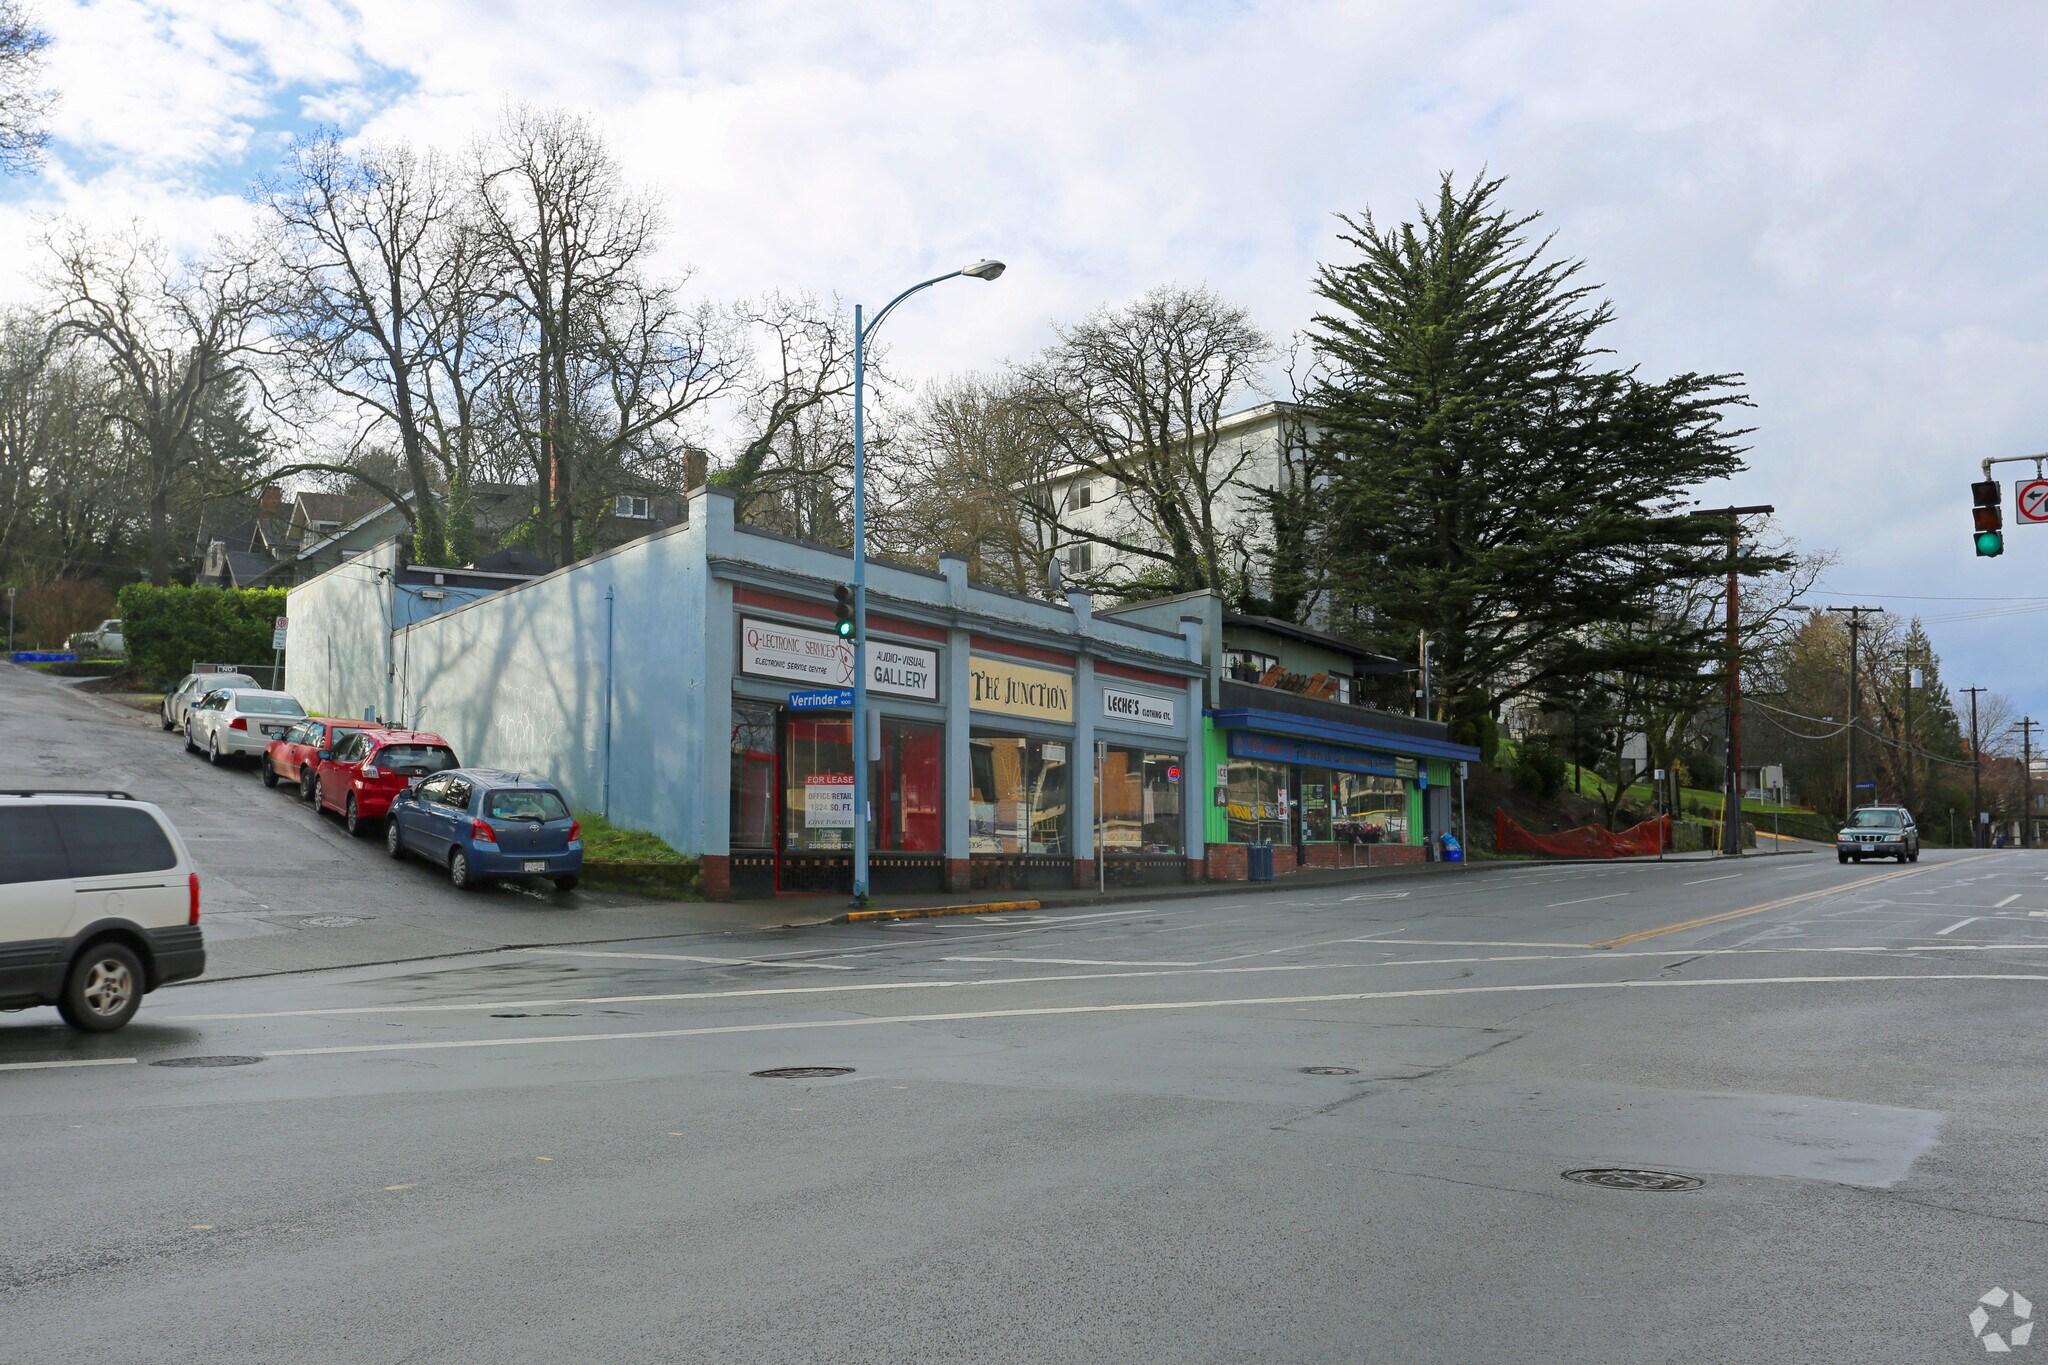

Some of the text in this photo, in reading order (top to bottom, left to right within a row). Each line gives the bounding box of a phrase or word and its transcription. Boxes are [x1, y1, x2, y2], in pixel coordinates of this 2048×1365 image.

[747, 629, 835, 658] Q-LECTRONIC SERVICES
[755, 657, 828, 675] ELECTRONIC SERVICE CENTRE
[876, 650, 926, 669] AUDIO-VISUAL
[874, 665, 928, 690] GALLERY
[970, 670, 1068, 710] THE JUNCTION
[791, 694, 838, 707] Verrinder
[1107, 695, 1172, 720] LECHE'S CLOTHING ETC.
[807, 776, 854, 784] FOR LEASE
[1217, 768, 1227, 778] ICE
[829, 803, 841, 812] SQ.
[842, 803, 852, 811] FT.
